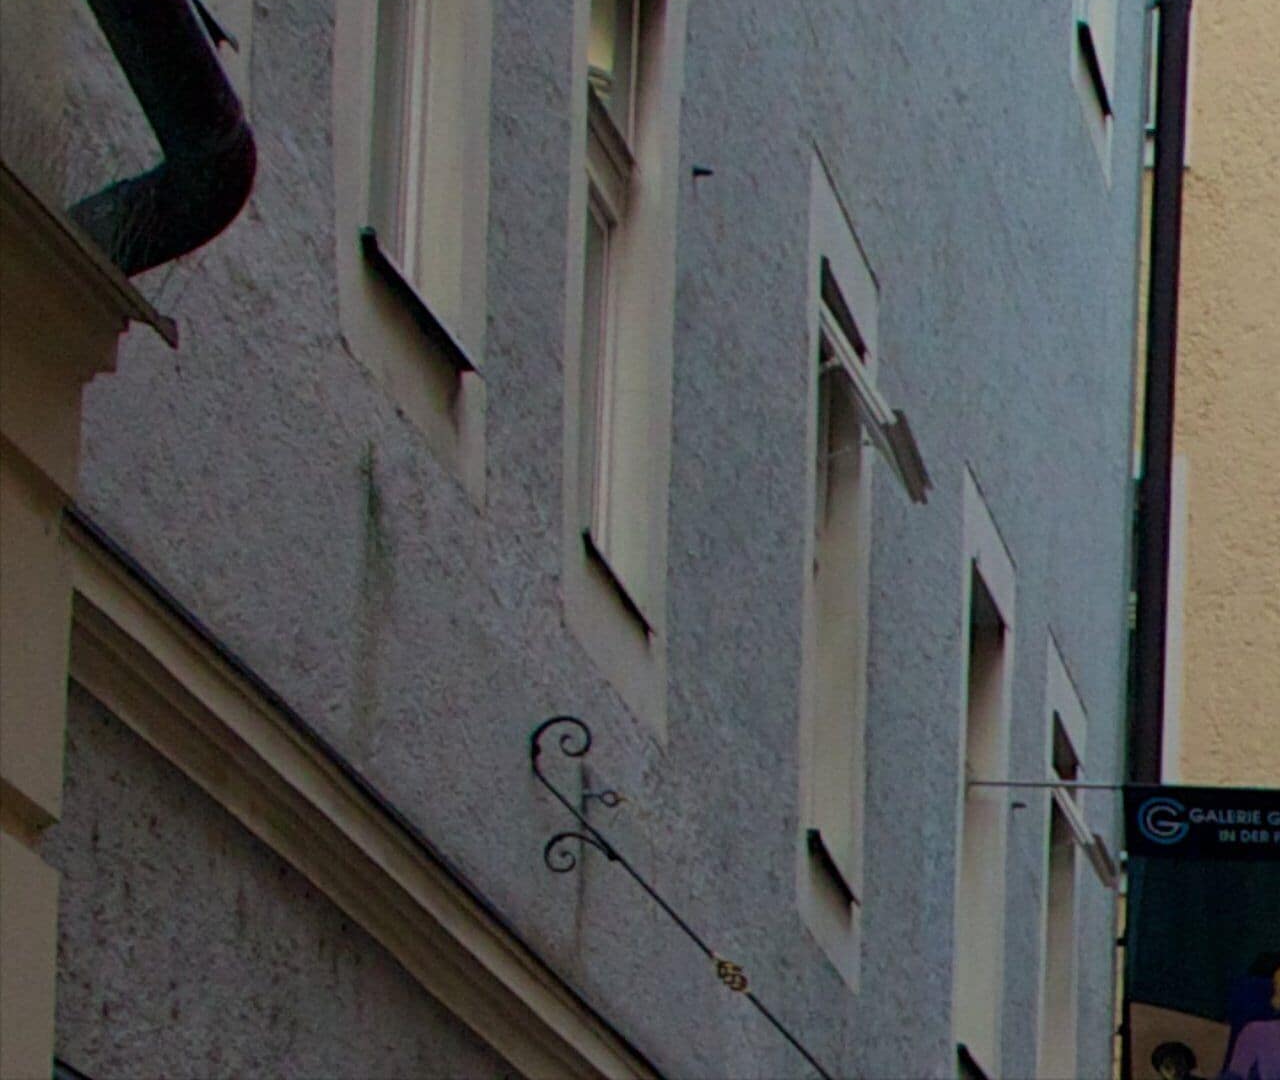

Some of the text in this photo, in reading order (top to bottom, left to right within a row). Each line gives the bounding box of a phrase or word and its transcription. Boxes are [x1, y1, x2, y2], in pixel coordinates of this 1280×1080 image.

[1188, 807, 1262, 825] GALERIE
[1218, 829, 1237, 843] IN
[1240, 830, 1270, 844] DER
